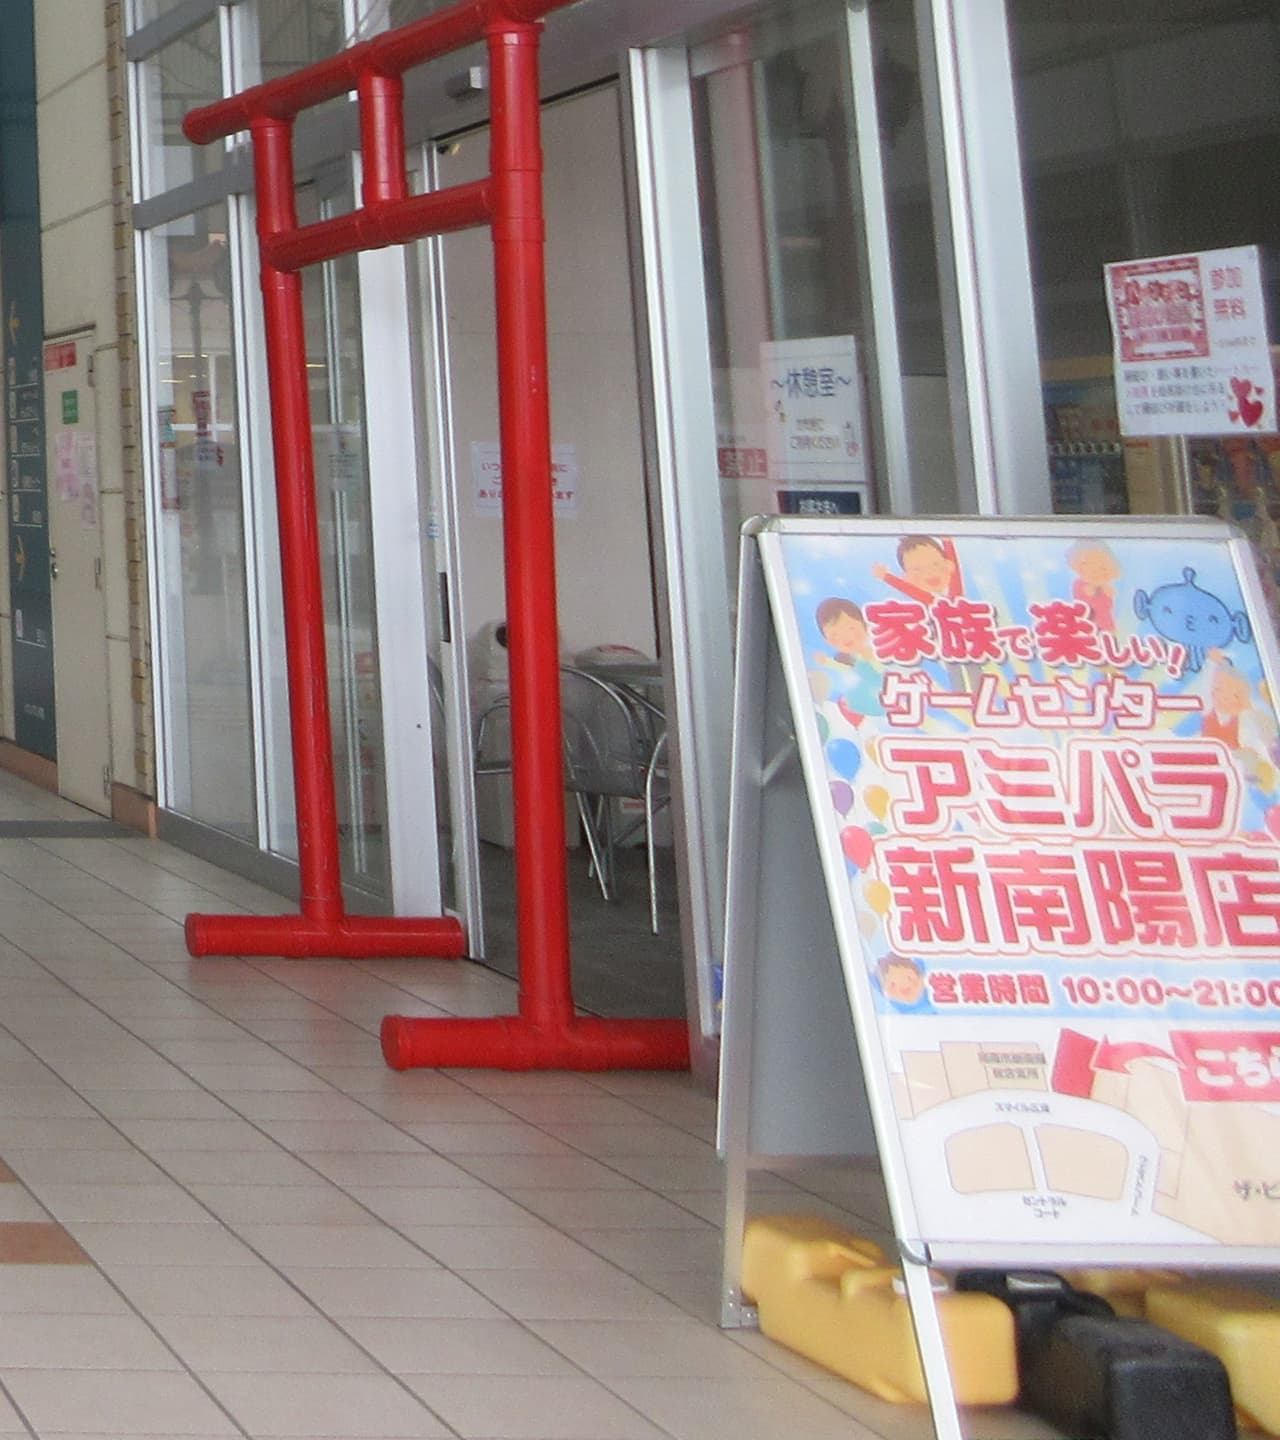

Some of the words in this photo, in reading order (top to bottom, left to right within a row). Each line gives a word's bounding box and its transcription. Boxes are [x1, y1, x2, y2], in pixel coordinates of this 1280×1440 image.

[880, 672, 1203, 729] ゲームセンター
[890, 748, 1228, 830] アミパラ
[884, 846, 1280, 948] 新南陽店
[928, 972, 1050, 1005] 営業時間
[1194, 1045, 1280, 1088] こち
